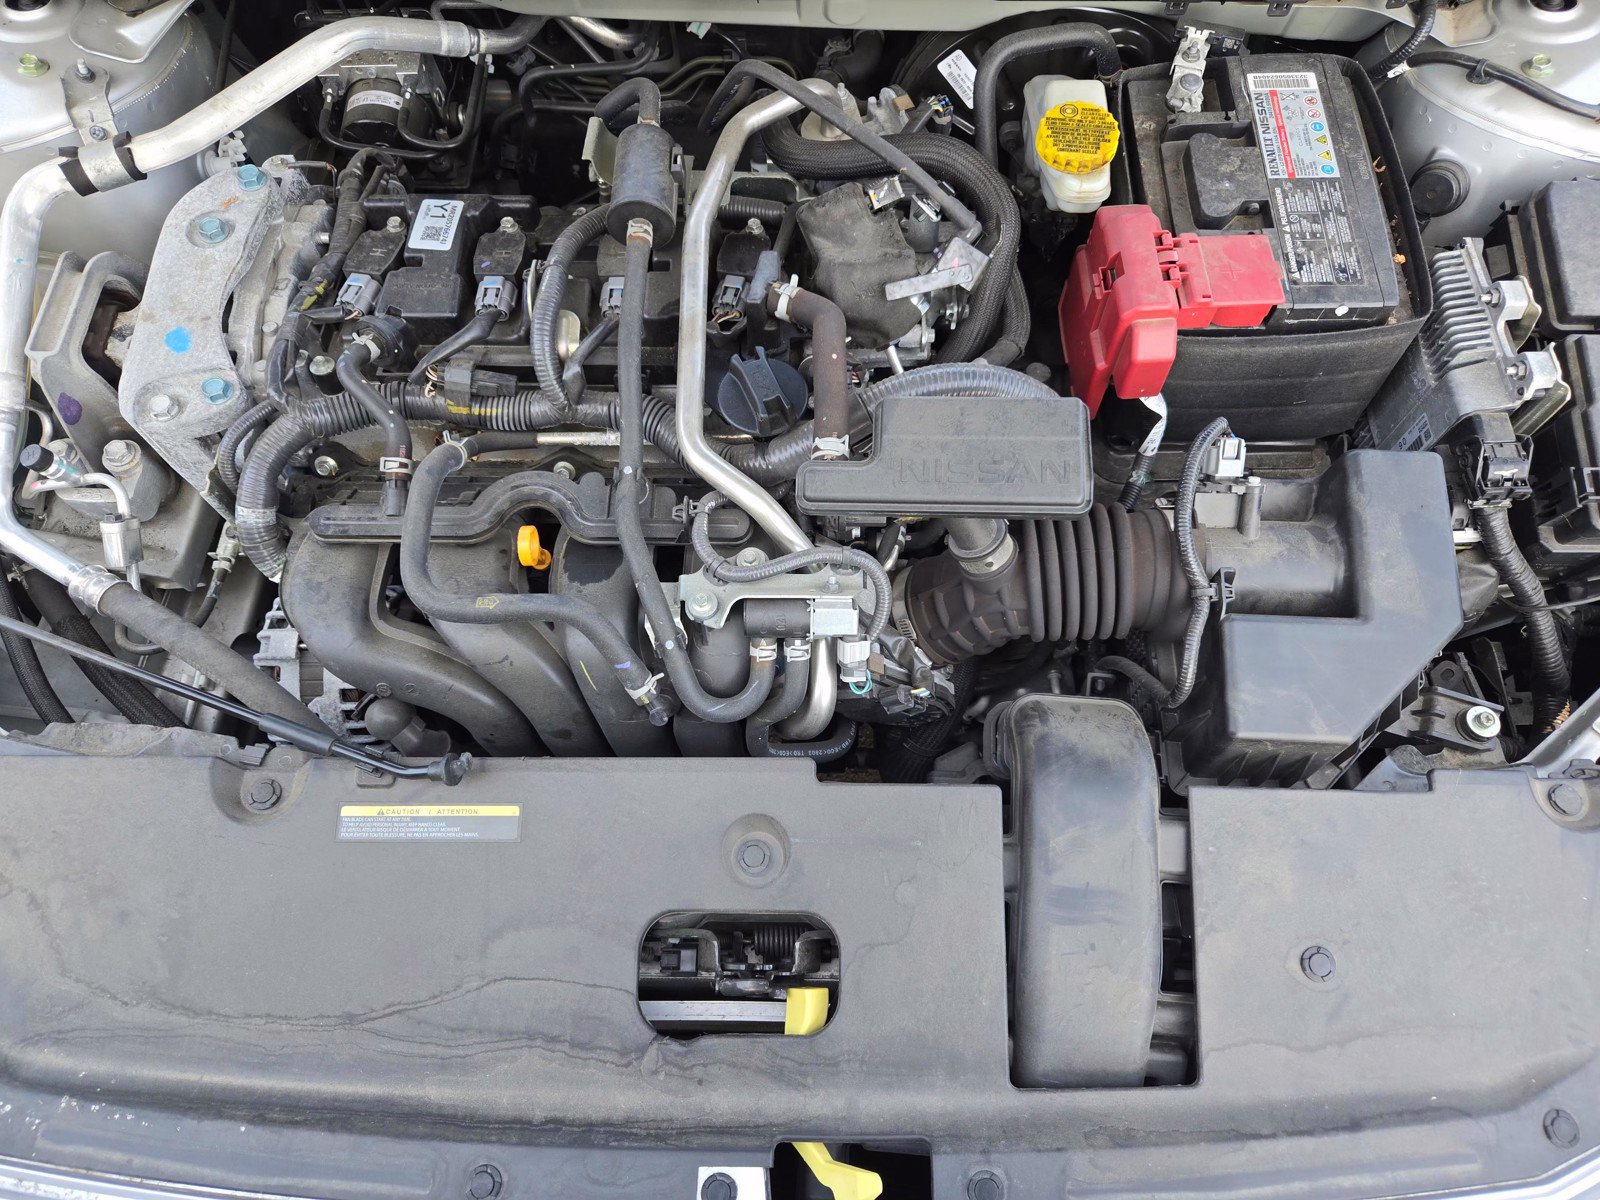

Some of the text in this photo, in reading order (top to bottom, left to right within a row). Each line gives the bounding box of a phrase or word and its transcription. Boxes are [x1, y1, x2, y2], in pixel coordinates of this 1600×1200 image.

[1253, 92, 1280, 175] RENAULT NISSAN
[431, 202, 450, 218] Y1
[1274, 187, 1298, 271] DANGER/POISON PELIGRO/VENENO
[900, 457, 1071, 484] NISSAN
